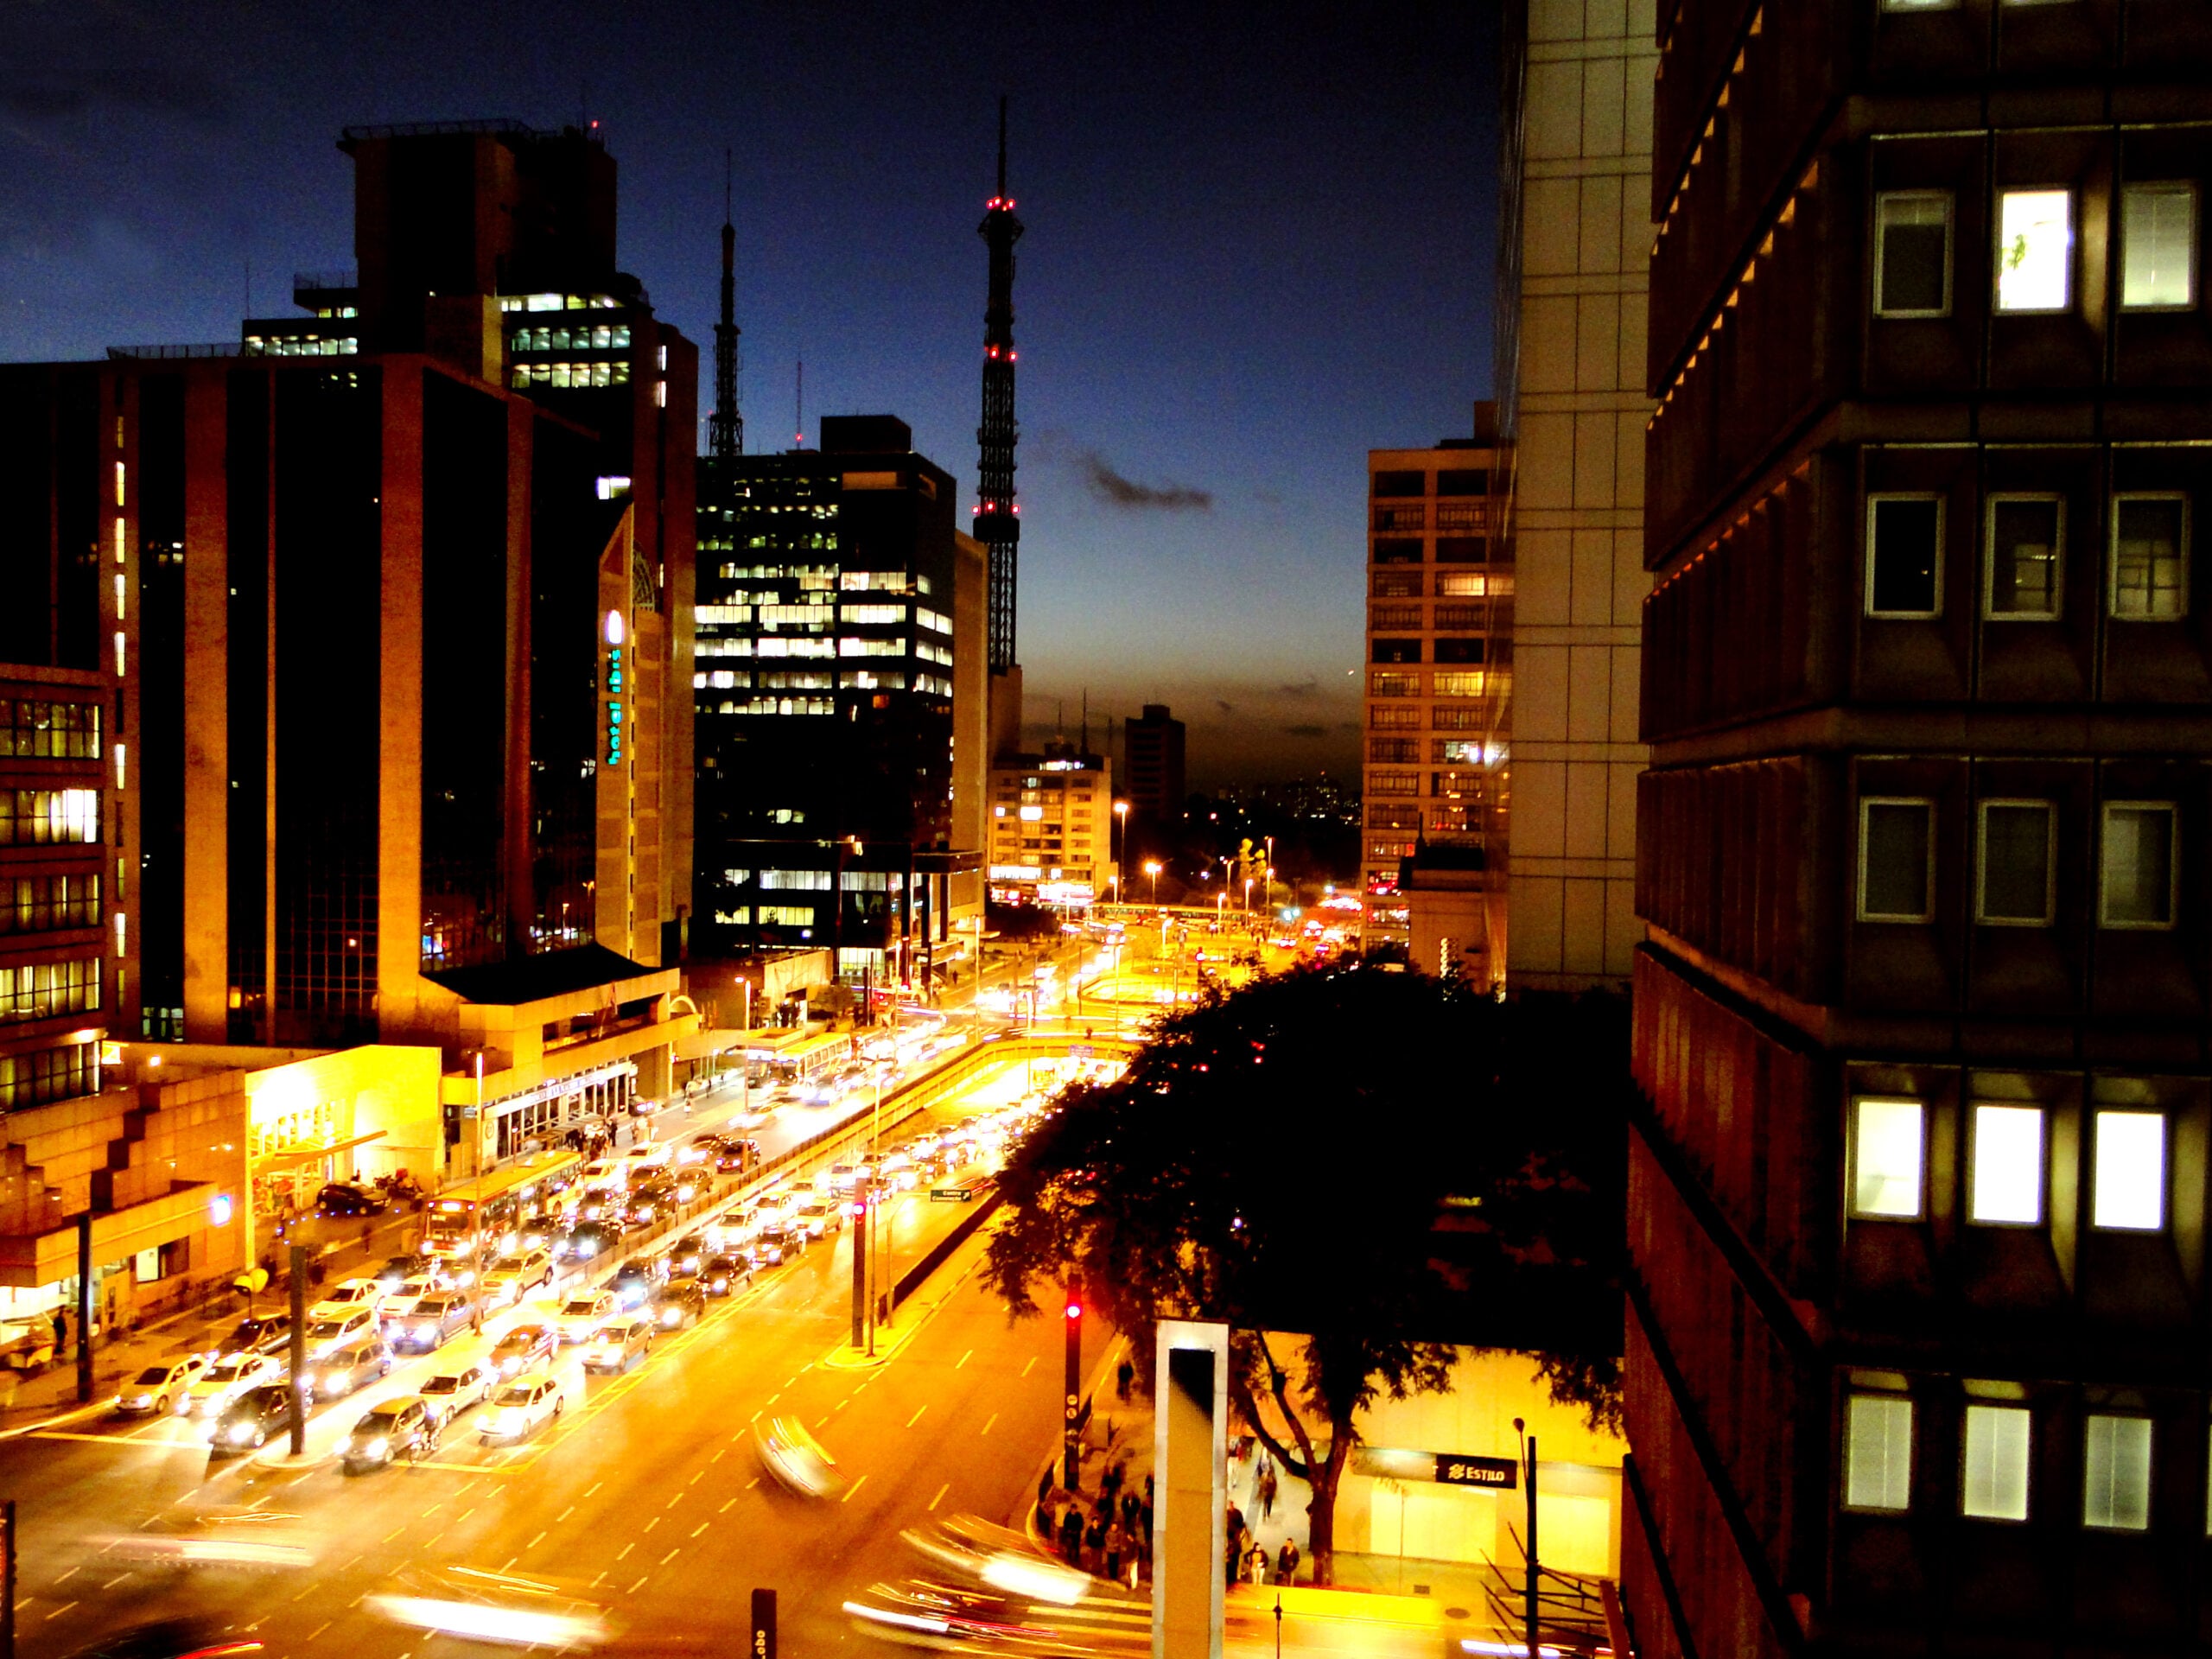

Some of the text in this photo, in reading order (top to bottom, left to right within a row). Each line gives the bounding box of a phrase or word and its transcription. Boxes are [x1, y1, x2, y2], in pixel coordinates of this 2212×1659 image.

[608, 649, 622, 765] hotel ibis
[754, 1630, 766, 1659] obo
